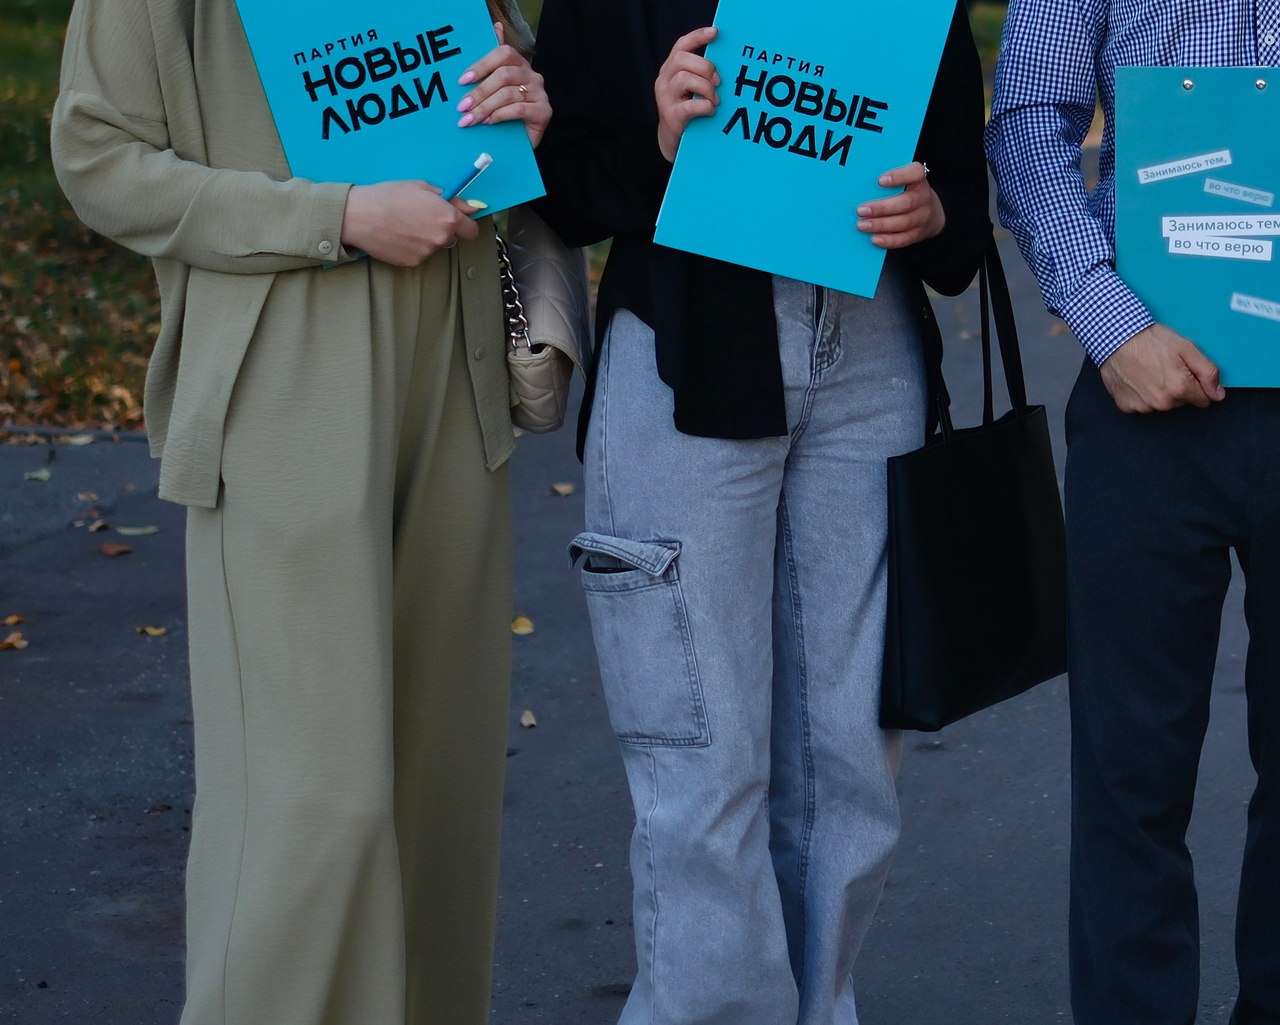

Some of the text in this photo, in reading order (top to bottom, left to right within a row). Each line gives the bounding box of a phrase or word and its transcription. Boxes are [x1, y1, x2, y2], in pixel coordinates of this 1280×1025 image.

[294, 29, 378, 65] ПАРТИЯ
[302, 24, 462, 102] НОВЫЕ
[742, 45, 825, 77] ПАРТИЯ
[322, 71, 448, 140] ЛЮДИ
[734, 64, 888, 133] НОВЫЕ
[722, 107, 853, 167] ЛЮДИ
[1143, 155, 1228, 180] Занимаюсь тем,
[1209, 182, 1221, 192] во
[1223, 185, 1241, 196] что
[1168, 219, 1253, 232] Занимаюсь
[1174, 239, 1264, 256] во что верю
